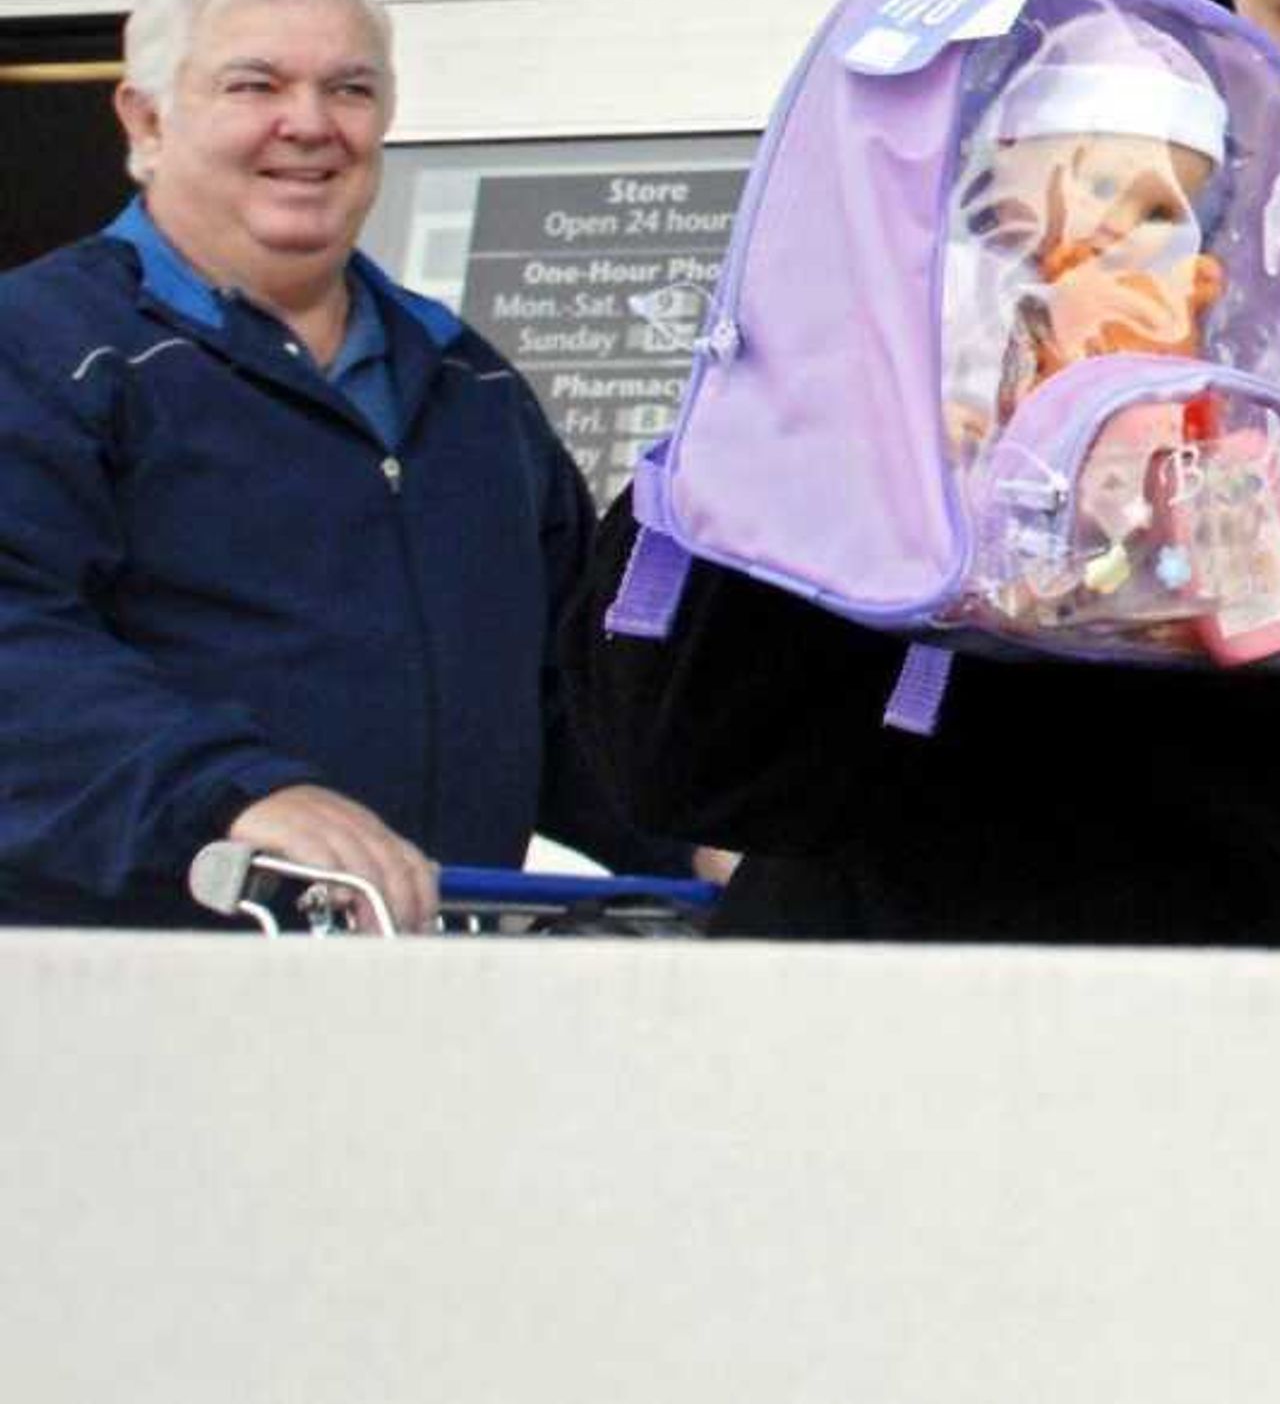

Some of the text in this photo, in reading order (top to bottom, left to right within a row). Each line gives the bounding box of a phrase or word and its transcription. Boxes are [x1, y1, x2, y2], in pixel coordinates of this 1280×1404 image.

[608, 177, 690, 204] Store
[544, 209, 731, 241] Open 24 hour
[524, 257, 722, 284] One-Hour Pho
[518, 325, 619, 358] Sunday
